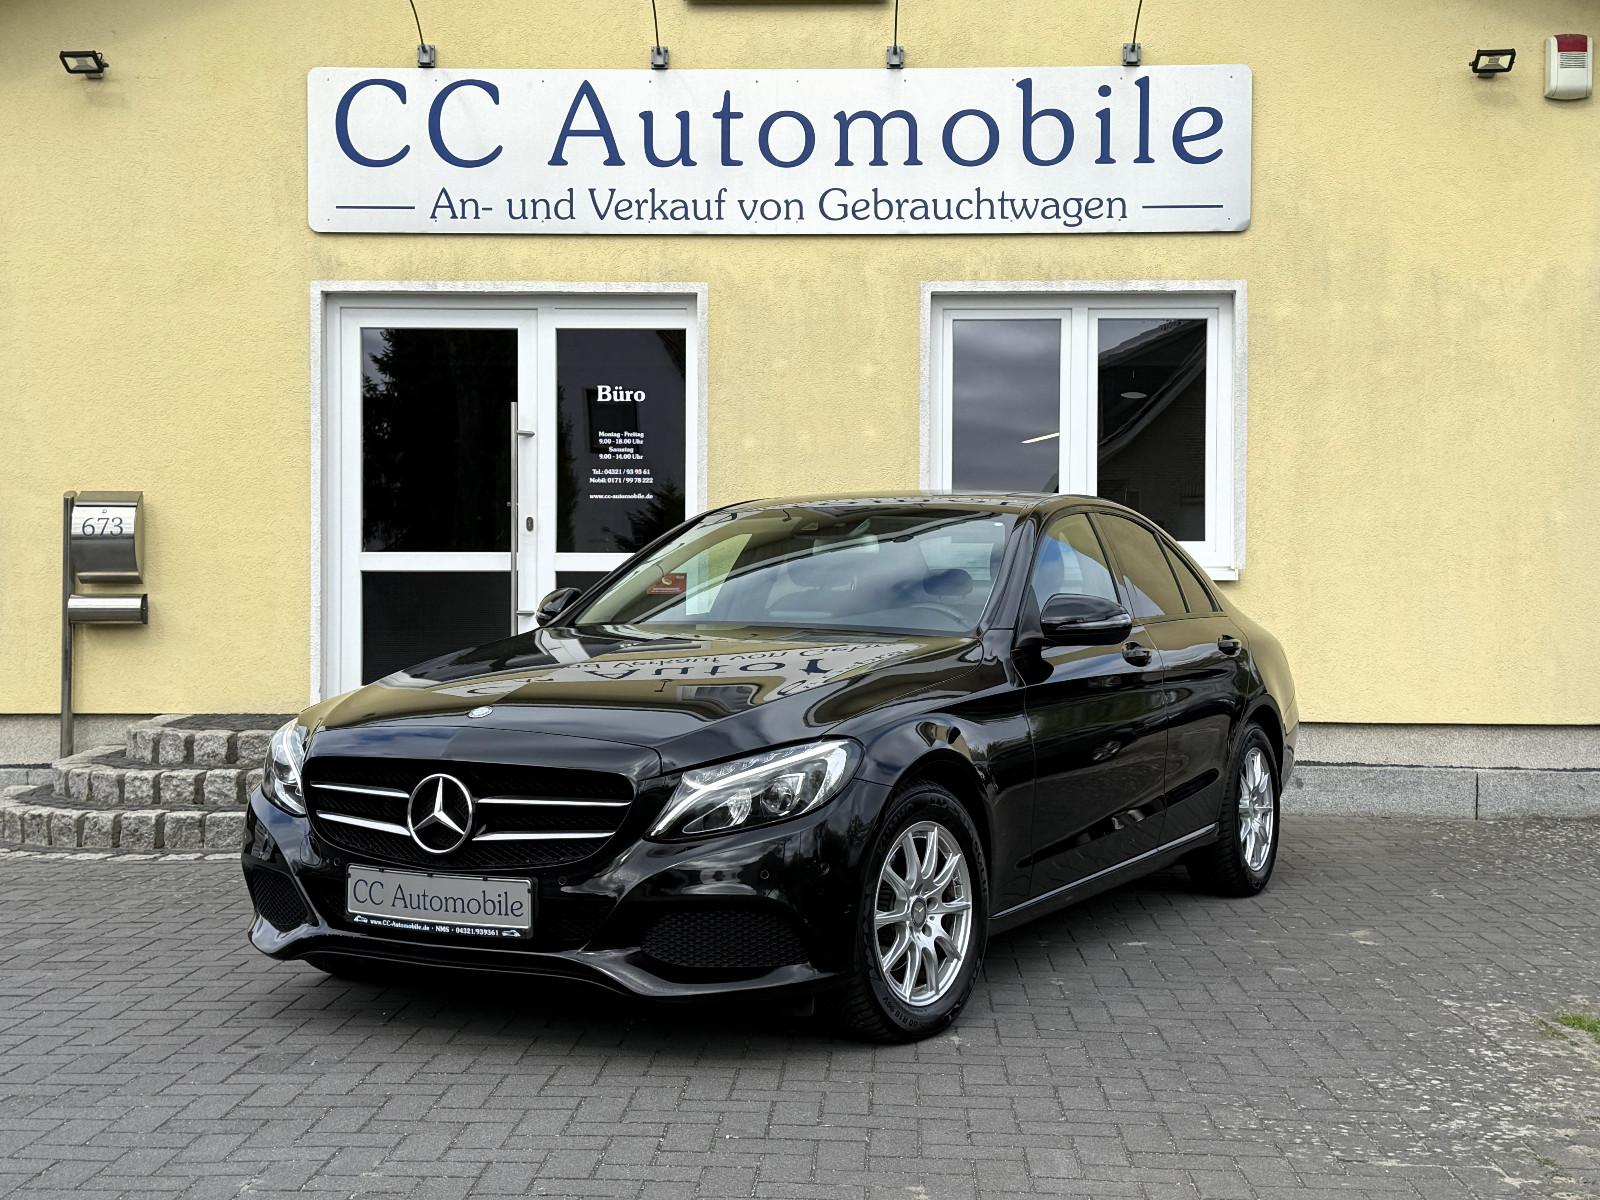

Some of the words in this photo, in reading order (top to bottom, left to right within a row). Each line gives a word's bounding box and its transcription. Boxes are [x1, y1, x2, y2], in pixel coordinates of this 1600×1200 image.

[335, 78, 503, 168] CC
[547, 77, 1224, 168] Automobile
[429, 186, 493, 221] An-
[506, 187, 575, 221] und
[588, 187, 727, 221] Verkauf
[738, 197, 804, 221] von
[818, 187, 1127, 227] Gebrauchtwagen
[596, 384, 646, 402] Büro
[598, 431, 621, 439] Montag
[624, 431, 645, 439] Freitag
[608, 446, 634, 454] Samstag
[589, 492, 654, 500] www.cc-automobile.de
[81, 516, 124, 537] 673
[353, 879, 385, 906] CC
[391, 883, 525, 918] Automobile
[435, 925, 450, 933] NMS
